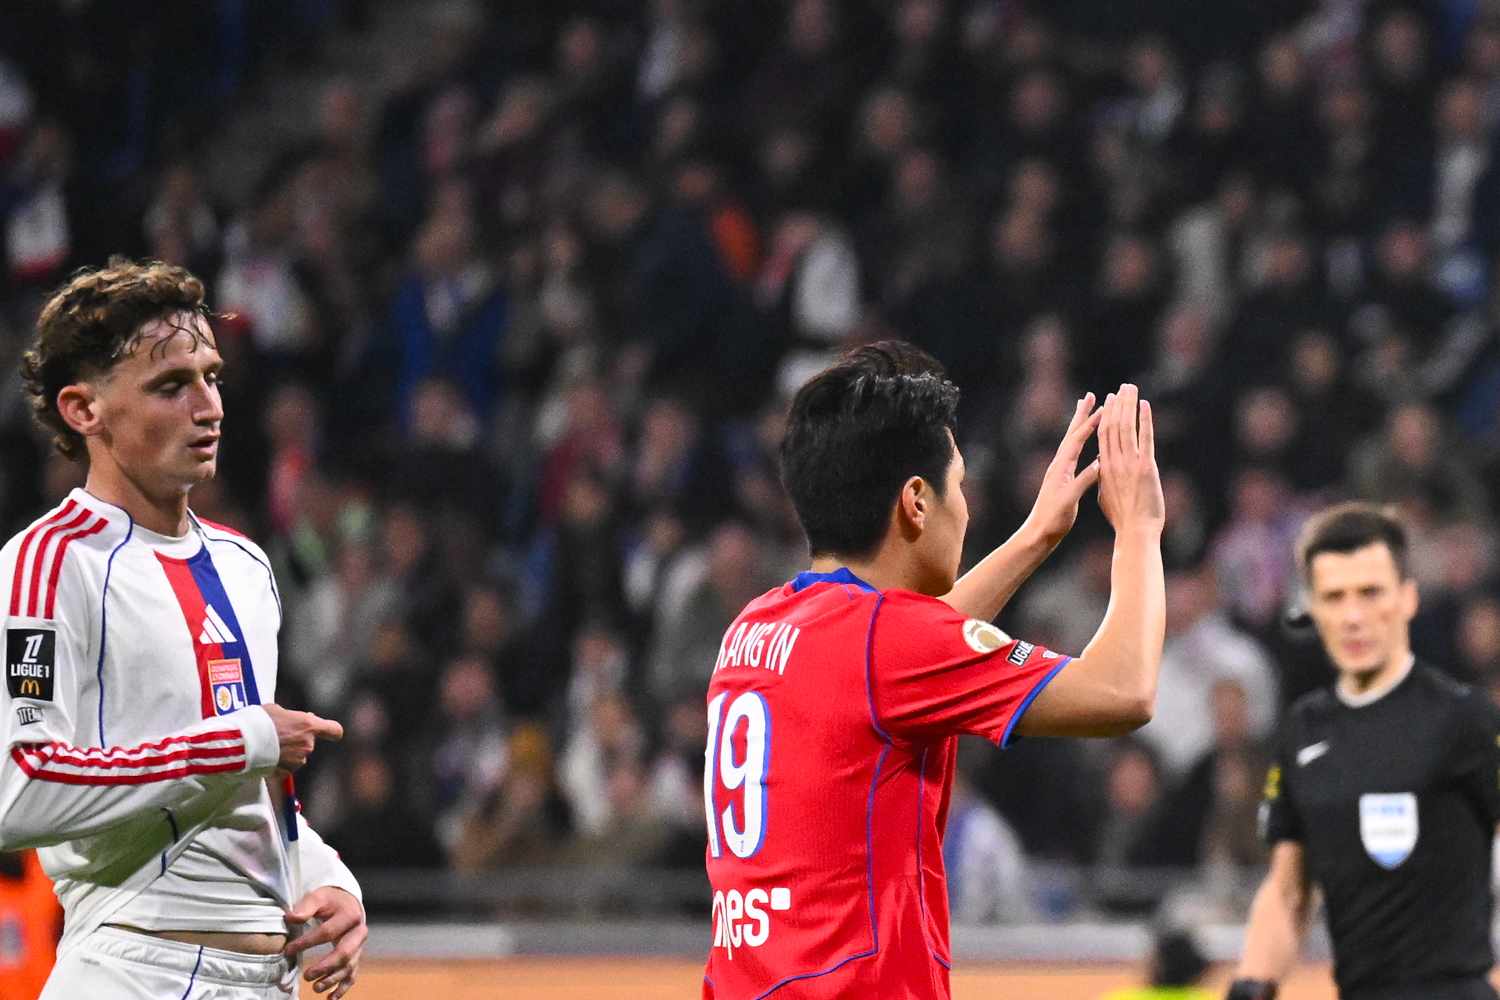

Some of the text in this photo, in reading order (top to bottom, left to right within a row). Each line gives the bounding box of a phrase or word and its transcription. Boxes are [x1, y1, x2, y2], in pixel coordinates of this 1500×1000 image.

[10, 663, 50, 678] LIGUE 1
[765, 622, 801, 676] IN
[703, 690, 772, 859] 19
